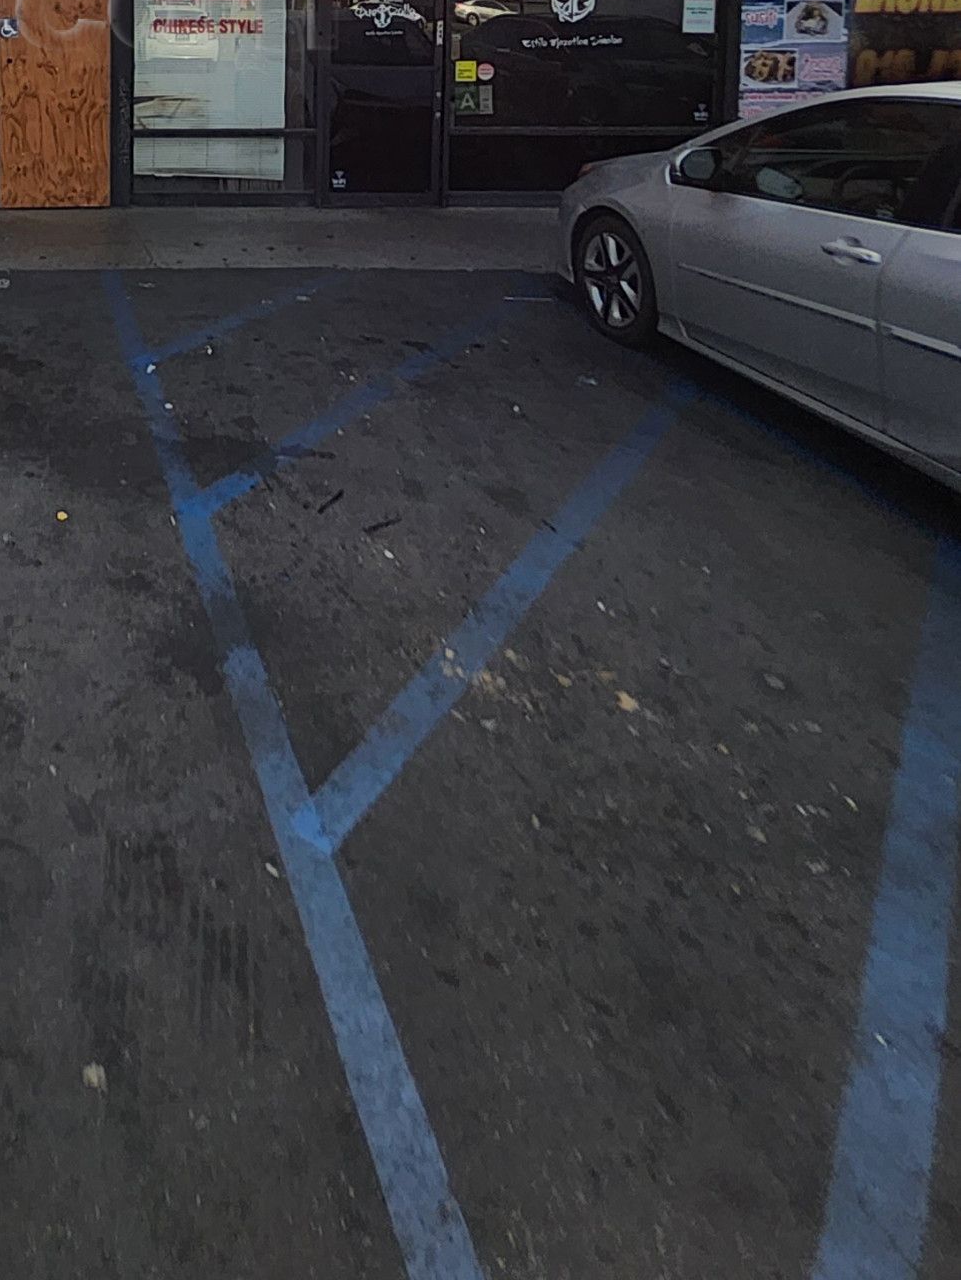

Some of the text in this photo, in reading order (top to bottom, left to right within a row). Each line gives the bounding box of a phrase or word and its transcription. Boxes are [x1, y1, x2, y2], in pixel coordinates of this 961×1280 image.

[153, 19, 263, 33] CHINESE STYLE
[460, 93, 476, 109] A
